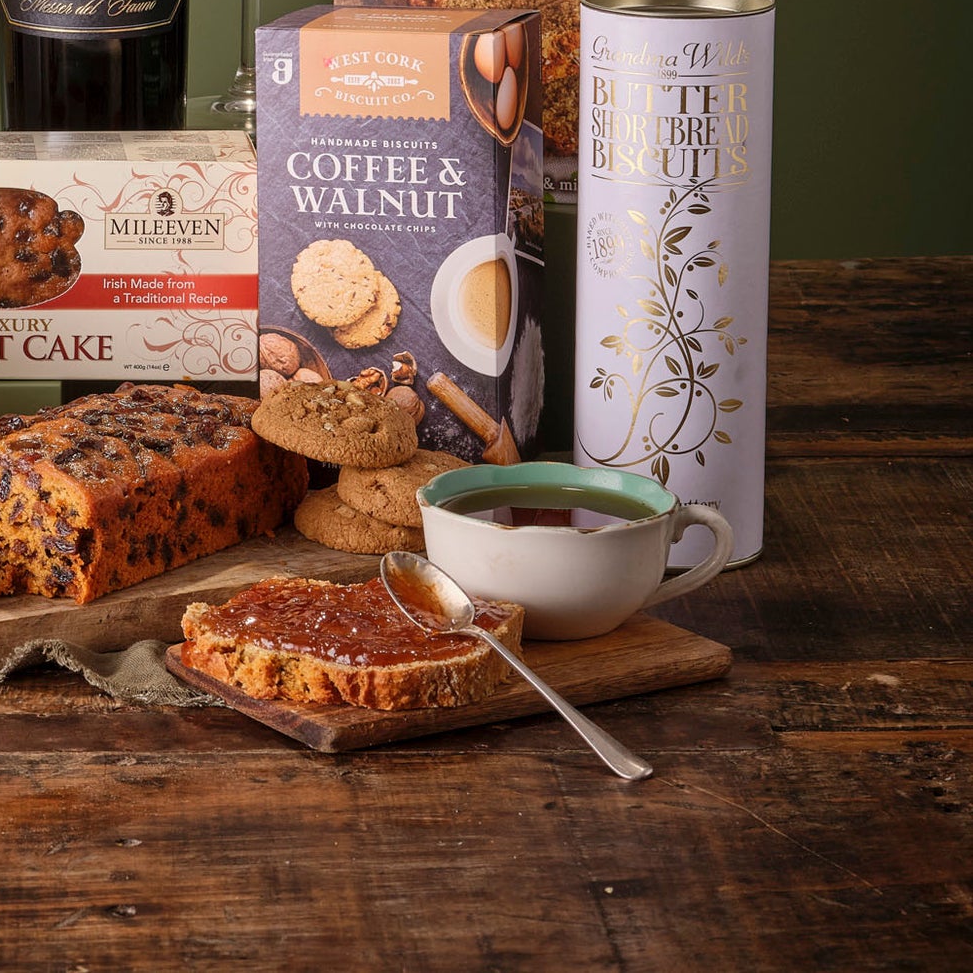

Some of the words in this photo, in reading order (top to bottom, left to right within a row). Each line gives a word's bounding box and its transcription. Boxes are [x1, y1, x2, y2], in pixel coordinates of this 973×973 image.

[328, 51, 371, 70] WEST
[374, 51, 425, 73] CORK
[591, 35, 678, 67] Grandma
[682, 40, 751, 70] Wild's
[335, 90, 389, 106] BISCUIT
[592, 76, 748, 115] BUTTER
[591, 107, 750, 146] SHORTBREAD
[311, 138, 377, 147] HANDMADE
[383, 140, 438, 149] BISCUITS
[591, 138, 751, 179] BISCUITS
[286, 151, 429, 184] COFFEE
[438, 157, 467, 186] &
[543, 177, 555, 190] &
[289, 185, 463, 219] WALNUT
[110, 218, 221, 235] MILEEVEN
[315, 221, 340, 229] WITH
[344, 222, 402, 232] CHOCOLATE
[406, 225, 436, 233] CHIPS
[138, 237, 167, 245] SINCE
[171, 237, 192, 245] 1988
[103, 278, 127, 289] Irish
[130, 278, 164, 289] Made
[167, 277, 195, 289] from
[113, 295, 120, 304] a
[123, 292, 185, 304] Traditional
[189, 293, 228, 307] Recipe
[23, 334, 113, 361] CAKE
